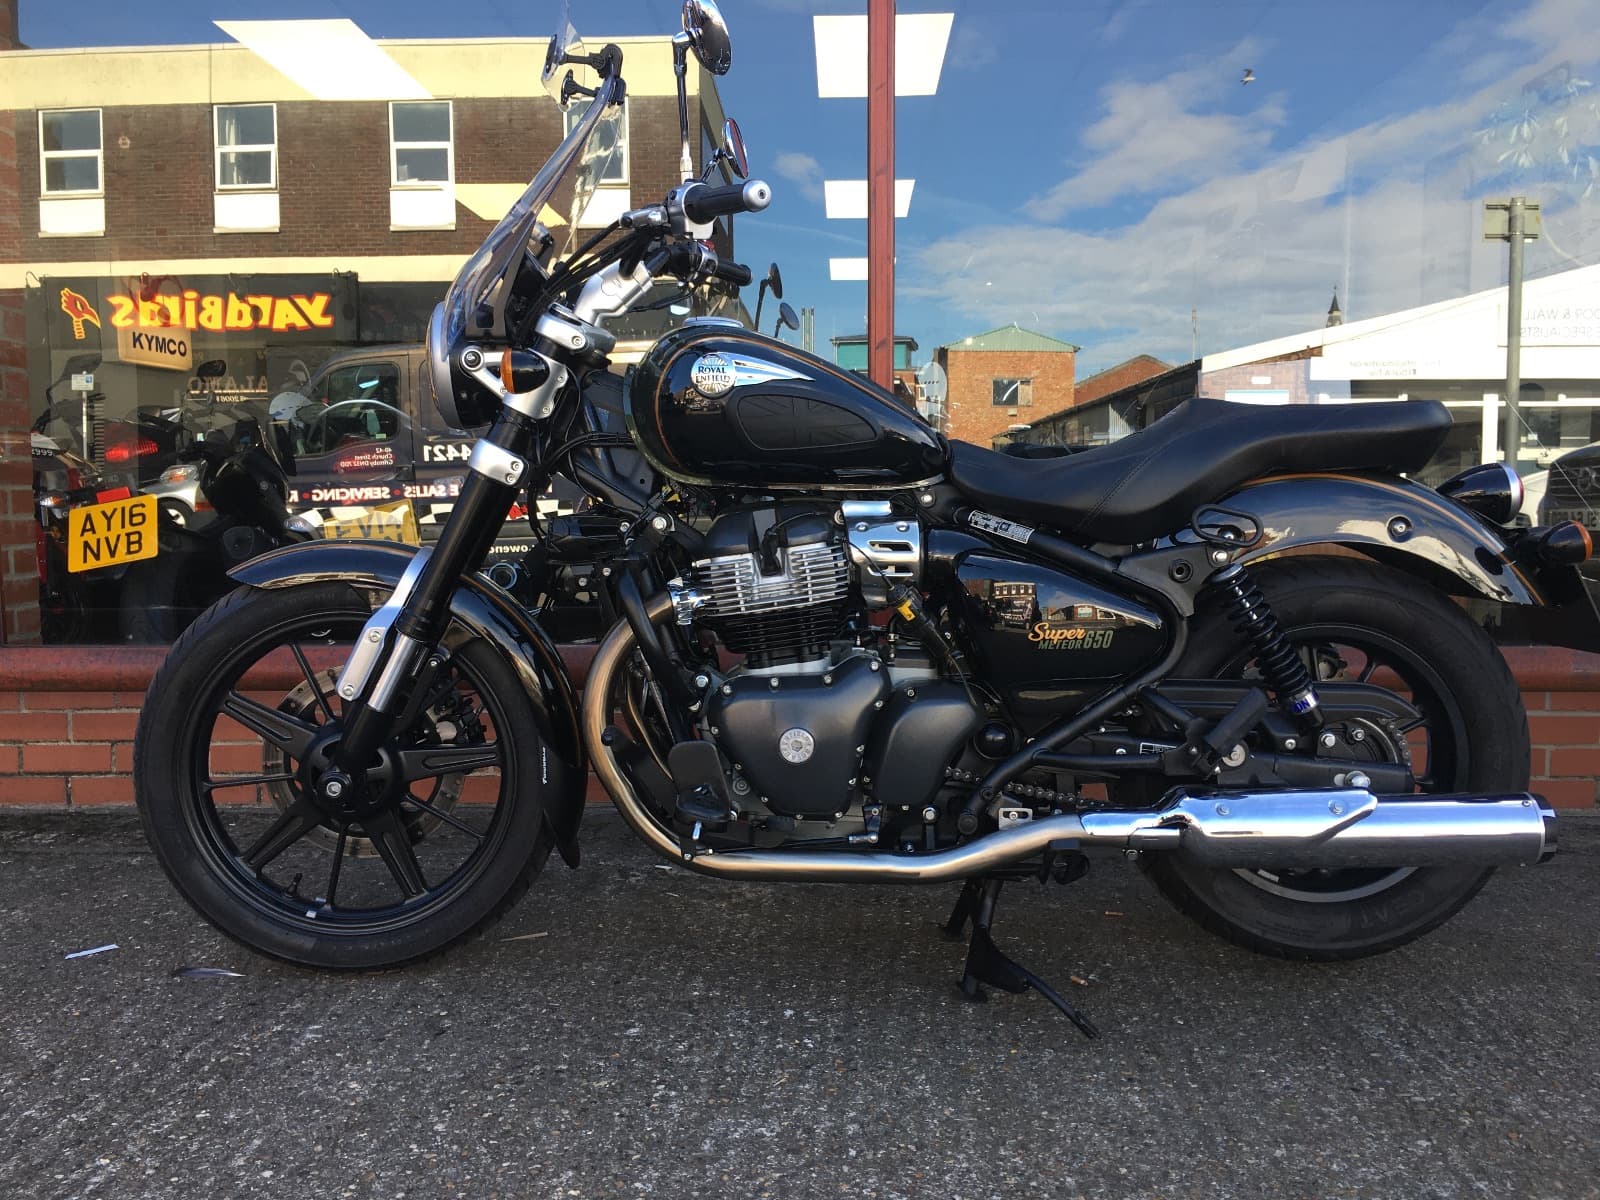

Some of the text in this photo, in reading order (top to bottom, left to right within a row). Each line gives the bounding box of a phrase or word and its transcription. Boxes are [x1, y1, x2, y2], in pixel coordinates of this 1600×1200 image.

[132, 331, 187, 357] KYMCO
[698, 366, 727, 374] ROYAL
[80, 503, 146, 537] AY16
[83, 530, 143, 564] NVB
[1028, 622, 1086, 644] Super
[1038, 630, 1114, 650] METEOR 650
